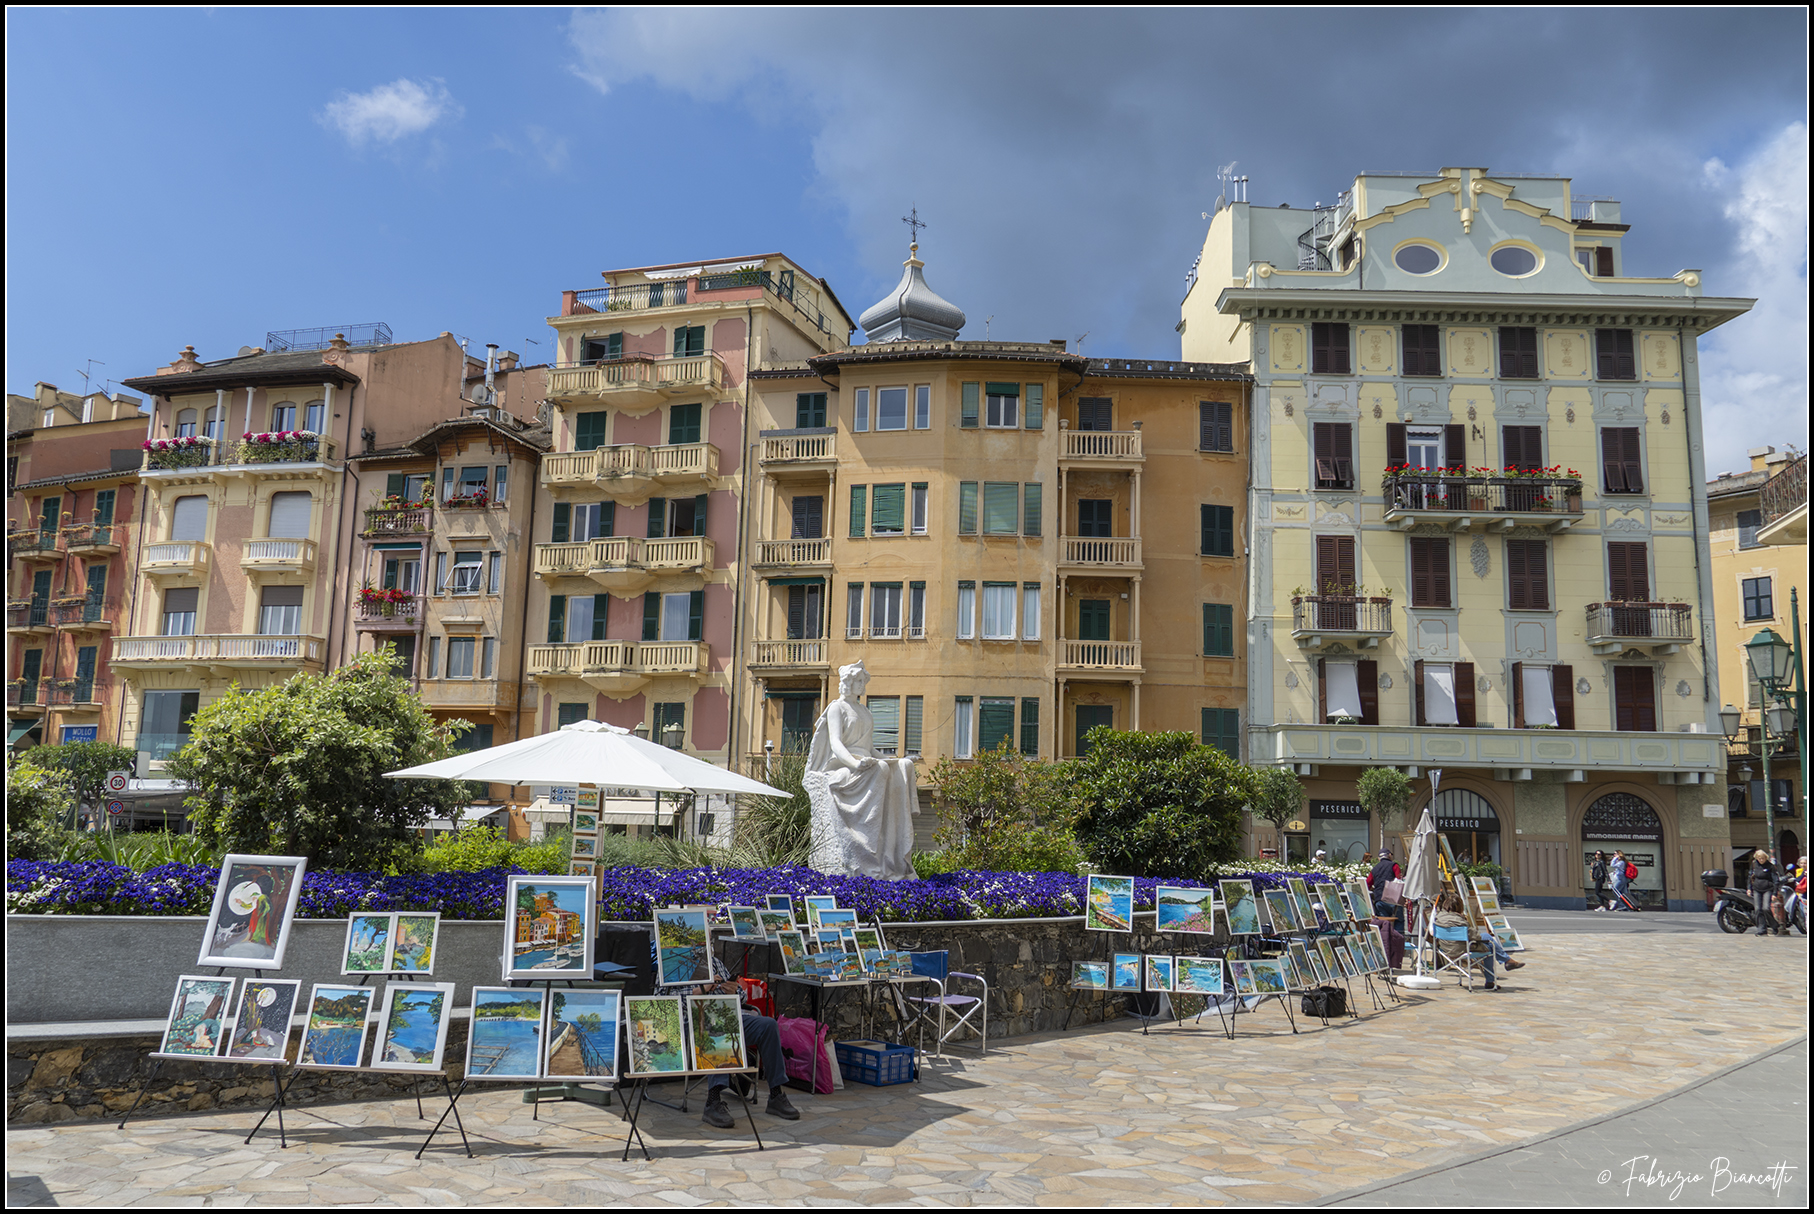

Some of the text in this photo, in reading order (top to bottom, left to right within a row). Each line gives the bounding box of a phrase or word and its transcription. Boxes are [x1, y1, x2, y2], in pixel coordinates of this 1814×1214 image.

[72, 727, 93, 736] MOLLO
[113, 779, 123, 787] 30
[1320, 804, 1360, 814] PESERICO
[1439, 819, 1480, 828] PESERICO
